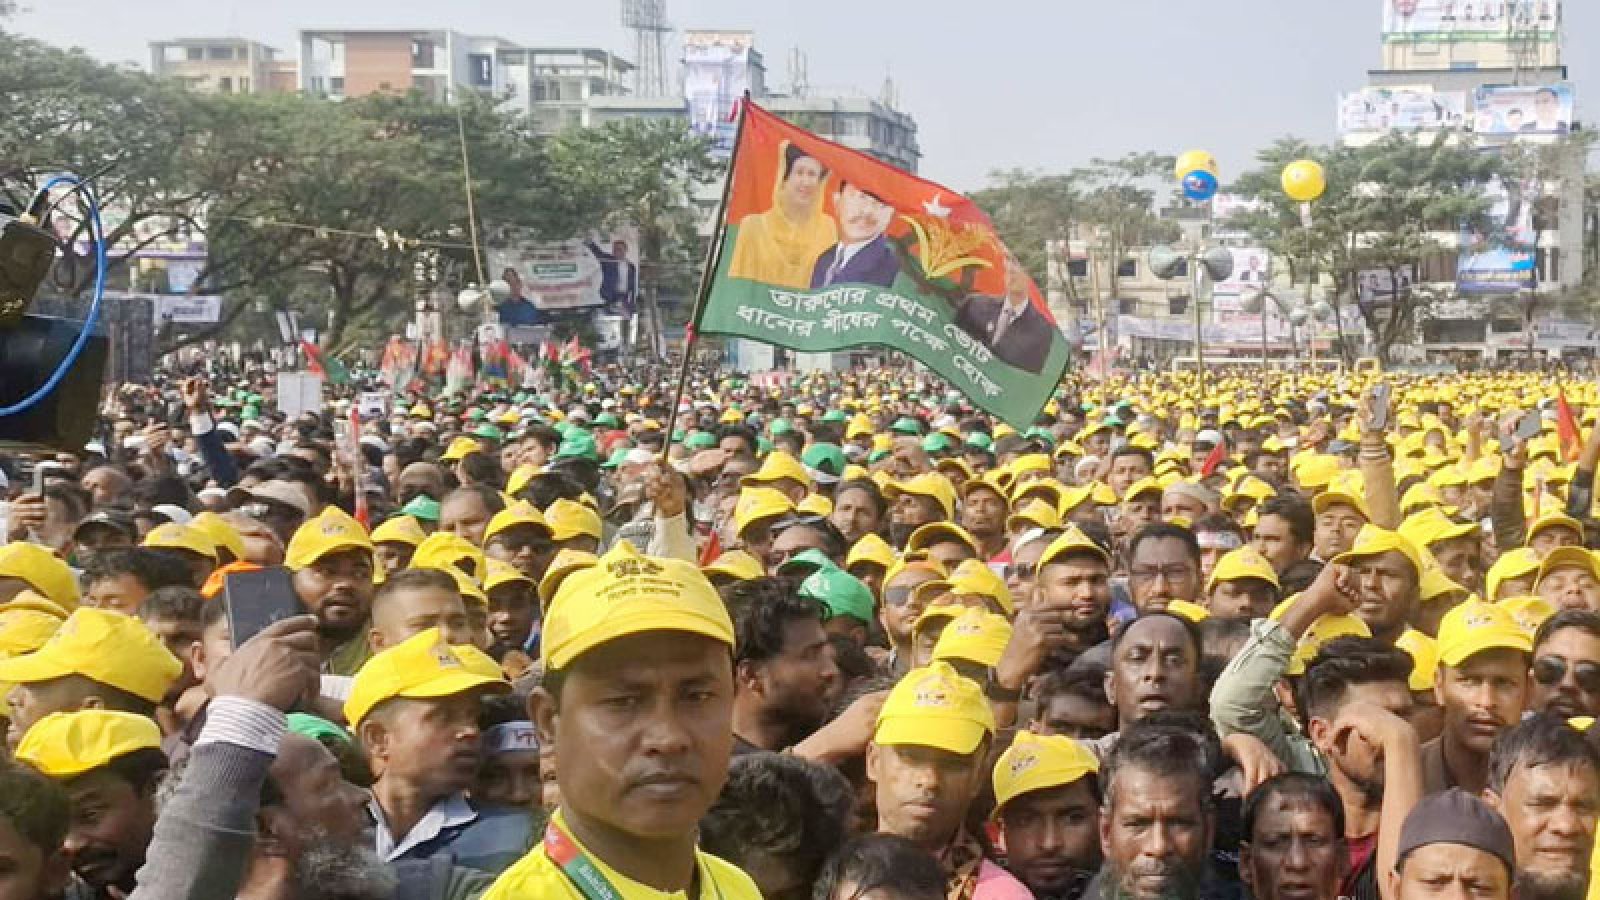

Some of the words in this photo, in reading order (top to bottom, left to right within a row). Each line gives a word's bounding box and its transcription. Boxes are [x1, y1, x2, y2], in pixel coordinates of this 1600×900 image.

[736, 305, 815, 337] ধানের
[821, 309, 884, 333] শীষের
[892, 319, 950, 350] পক্ষে
[875, 293, 938, 324] প্রথম
[943, 324, 993, 362] ভোট
